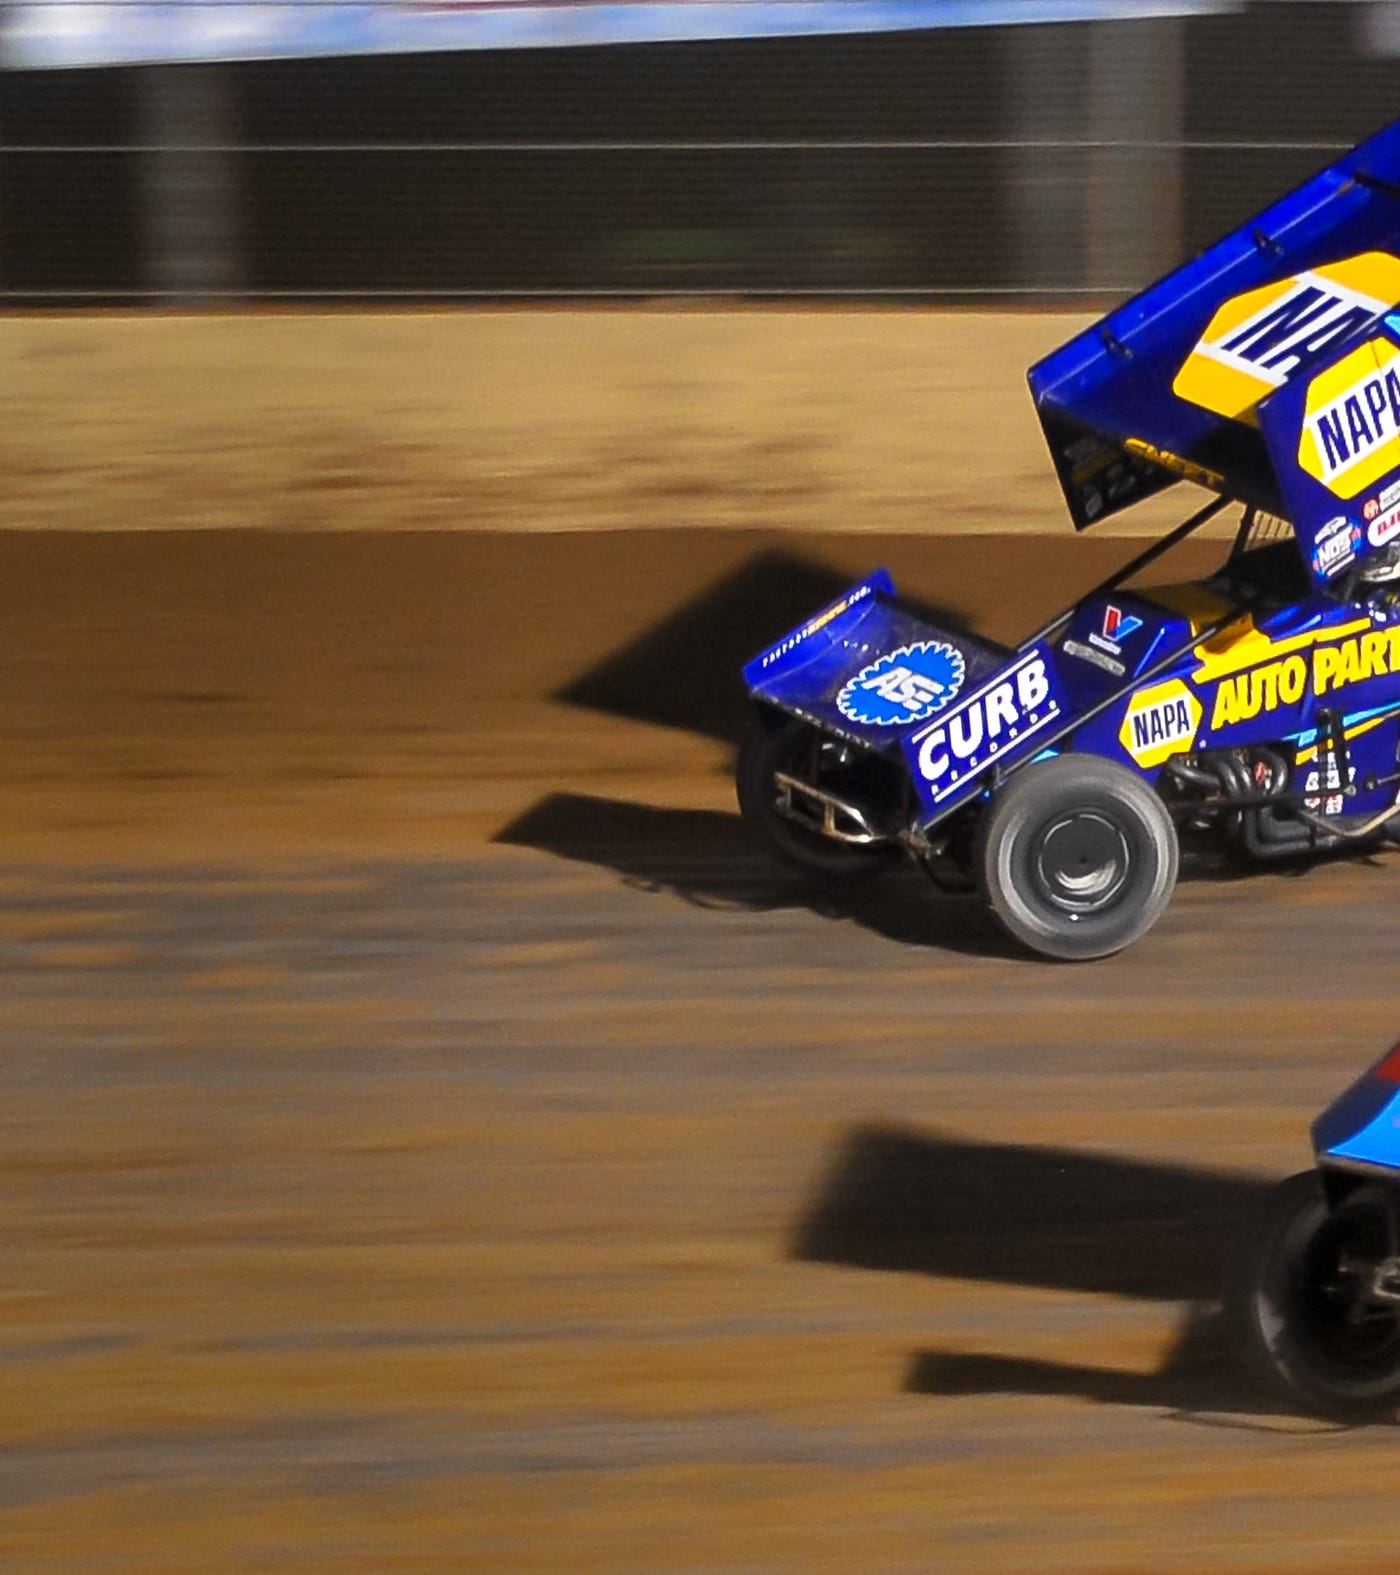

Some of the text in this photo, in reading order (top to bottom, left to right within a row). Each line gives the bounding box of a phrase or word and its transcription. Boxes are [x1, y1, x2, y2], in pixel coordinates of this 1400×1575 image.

[918, 659, 1050, 781] CURB
[1133, 700, 1191, 748] NAPA
[1210, 655, 1307, 731] AUTO
